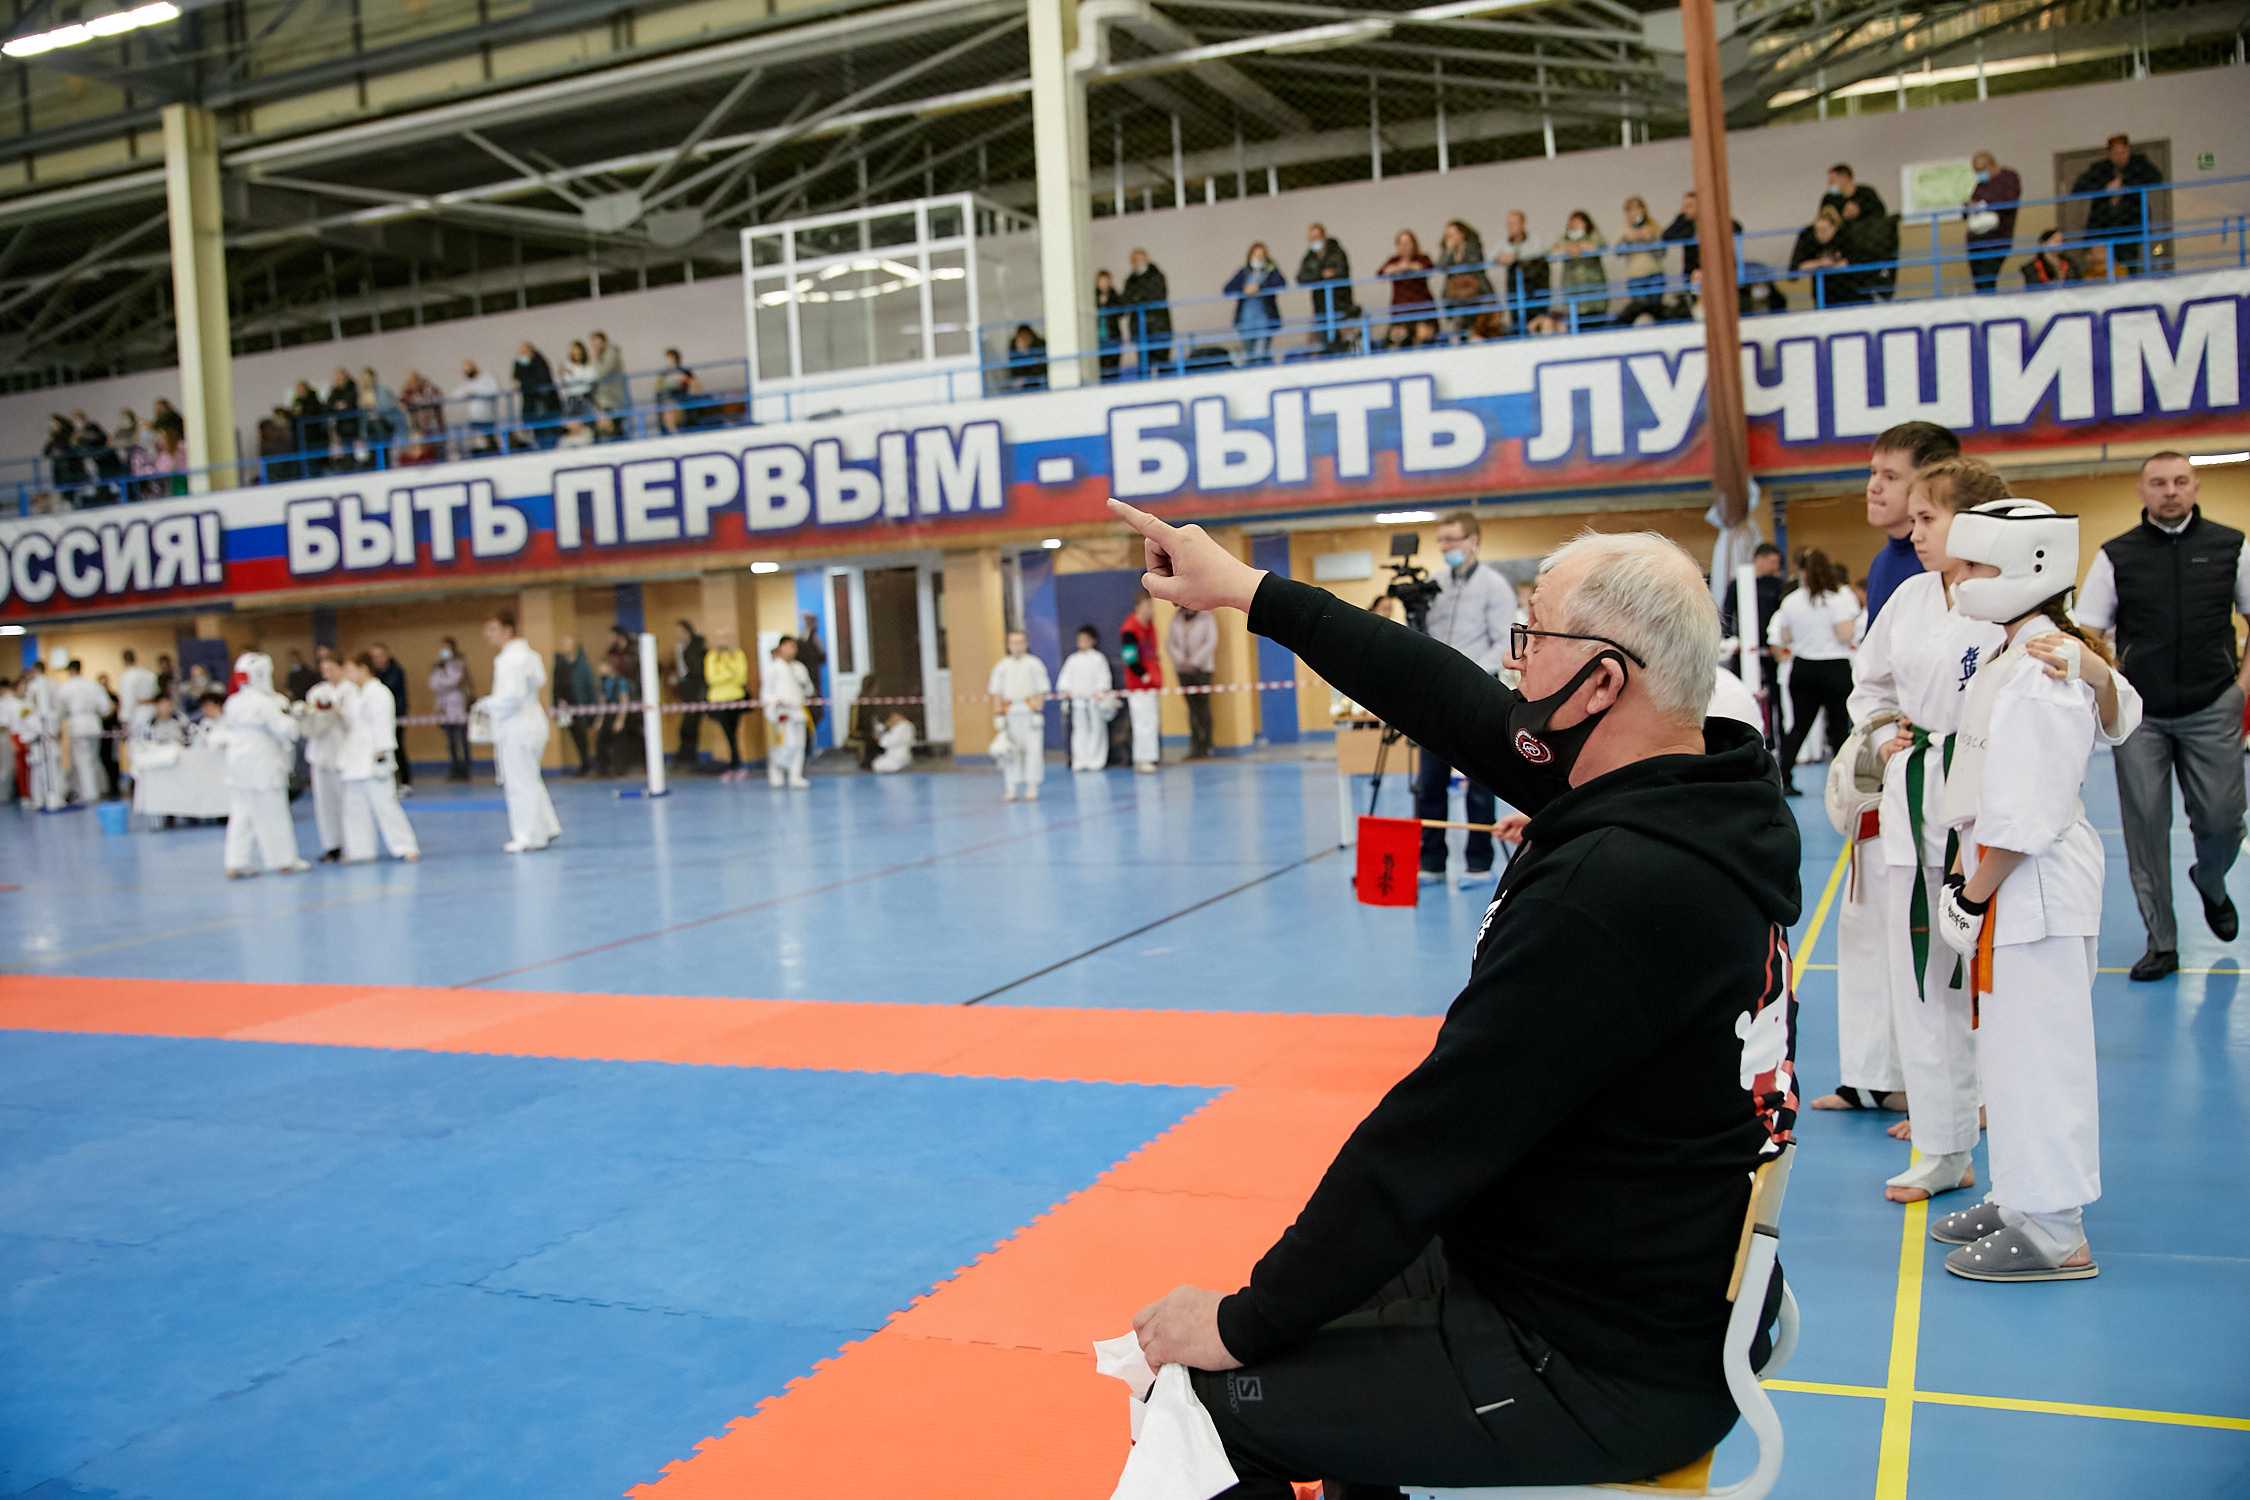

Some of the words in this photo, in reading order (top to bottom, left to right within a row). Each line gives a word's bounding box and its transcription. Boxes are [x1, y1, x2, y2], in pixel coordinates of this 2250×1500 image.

[0, 512, 223, 605] ССИЯ!
[289, 481, 528, 575] БЫТЬ
[555, 423, 1002, 548] ПЕРВЫМ
[1039, 457, 1074, 483] -
[1111, 377, 1487, 496] БЫТЬ
[1527, 299, 2240, 463] ЛУЧШИМ
